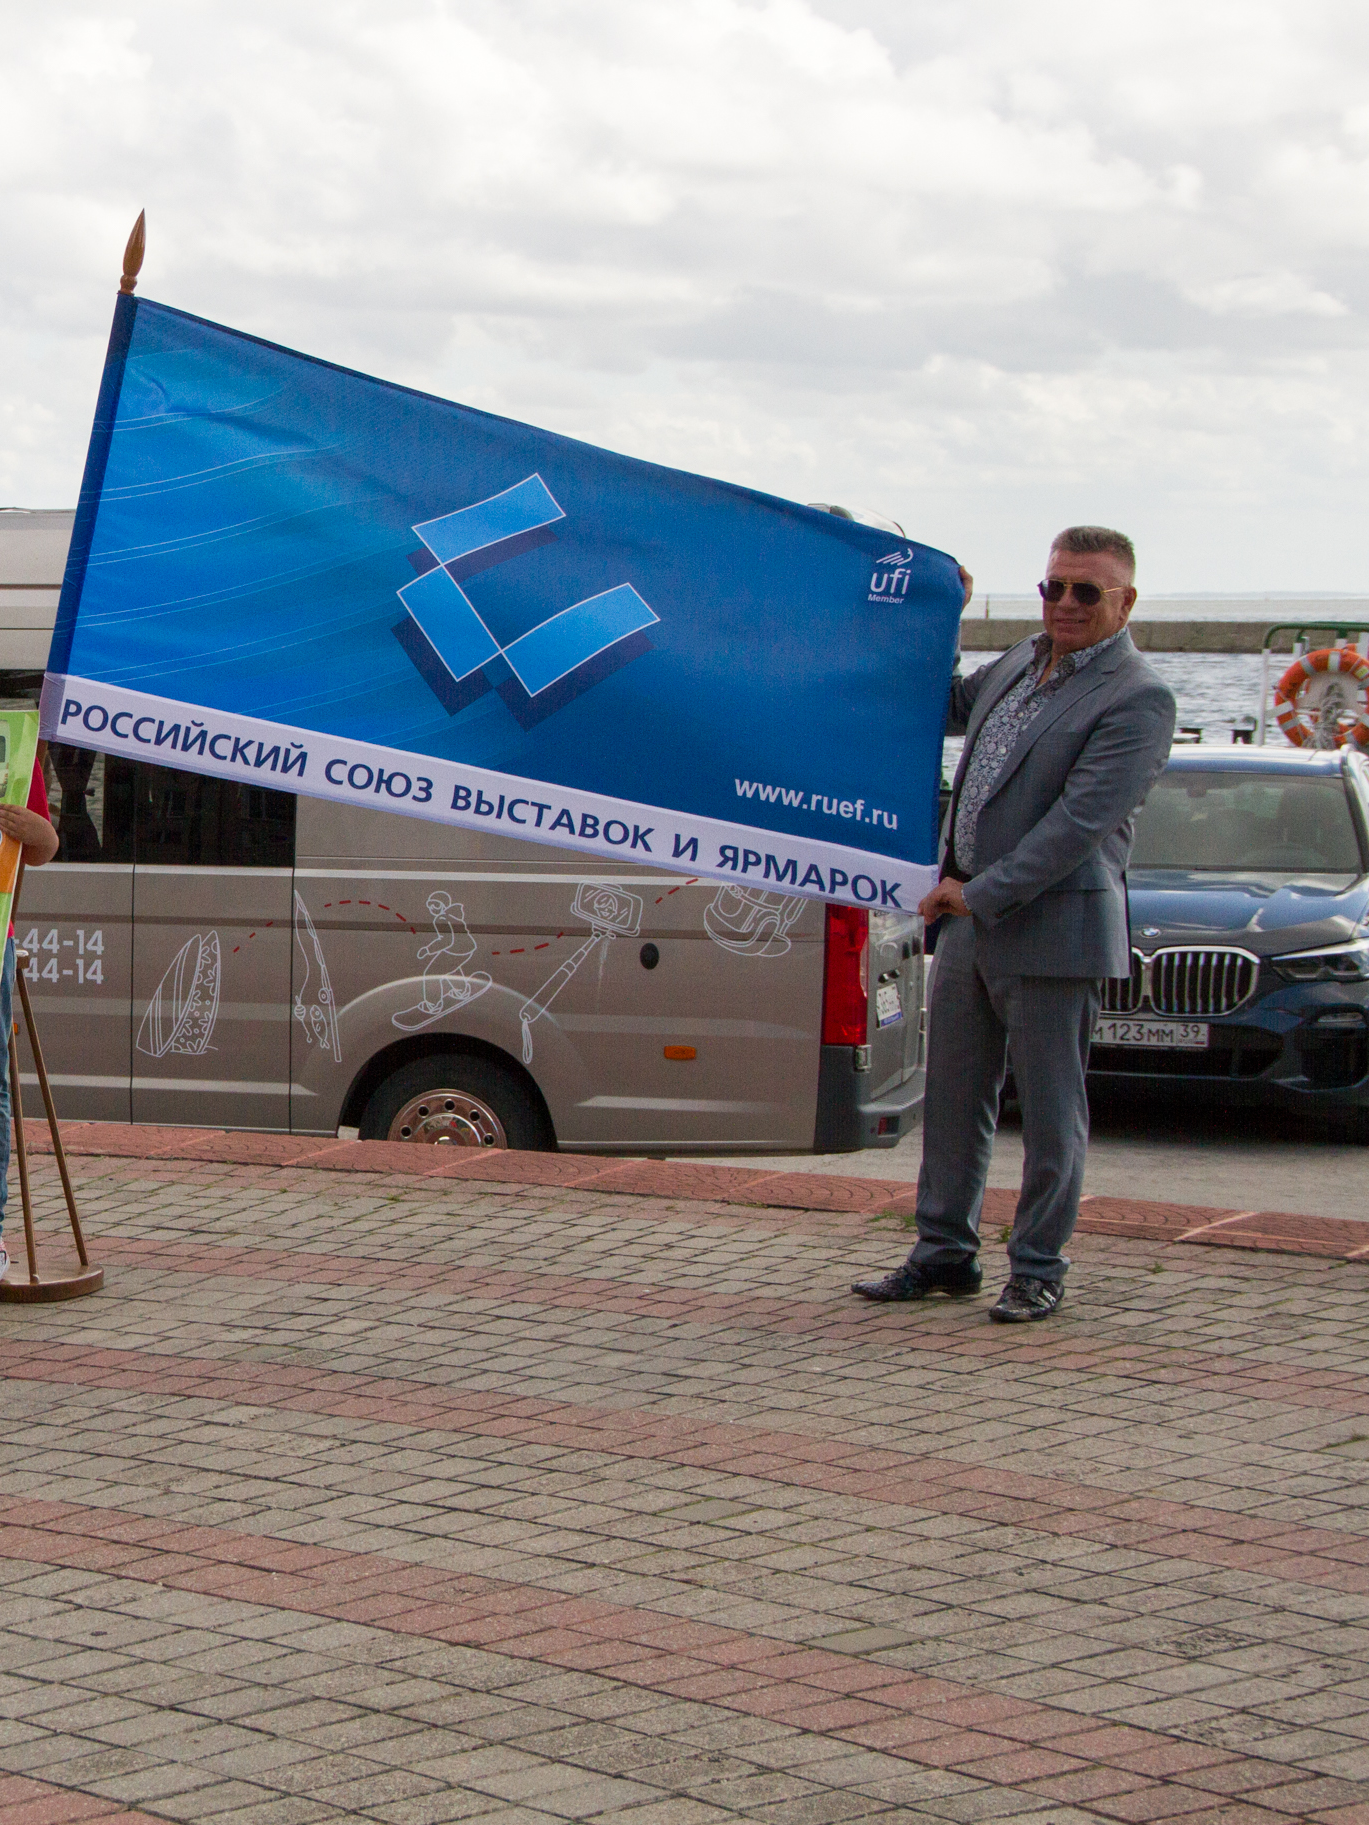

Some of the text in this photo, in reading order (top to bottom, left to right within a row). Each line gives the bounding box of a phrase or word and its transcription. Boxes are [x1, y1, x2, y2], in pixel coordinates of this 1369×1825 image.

[867, 593, 905, 604] Member
[870, 568, 911, 595] ufi
[60, 699, 903, 909] РОССИЙСКИЙ СОЮЗ ВЫСТАВОК И ЯРМАРОК
[734, 778, 898, 830] www.ruef.ru
